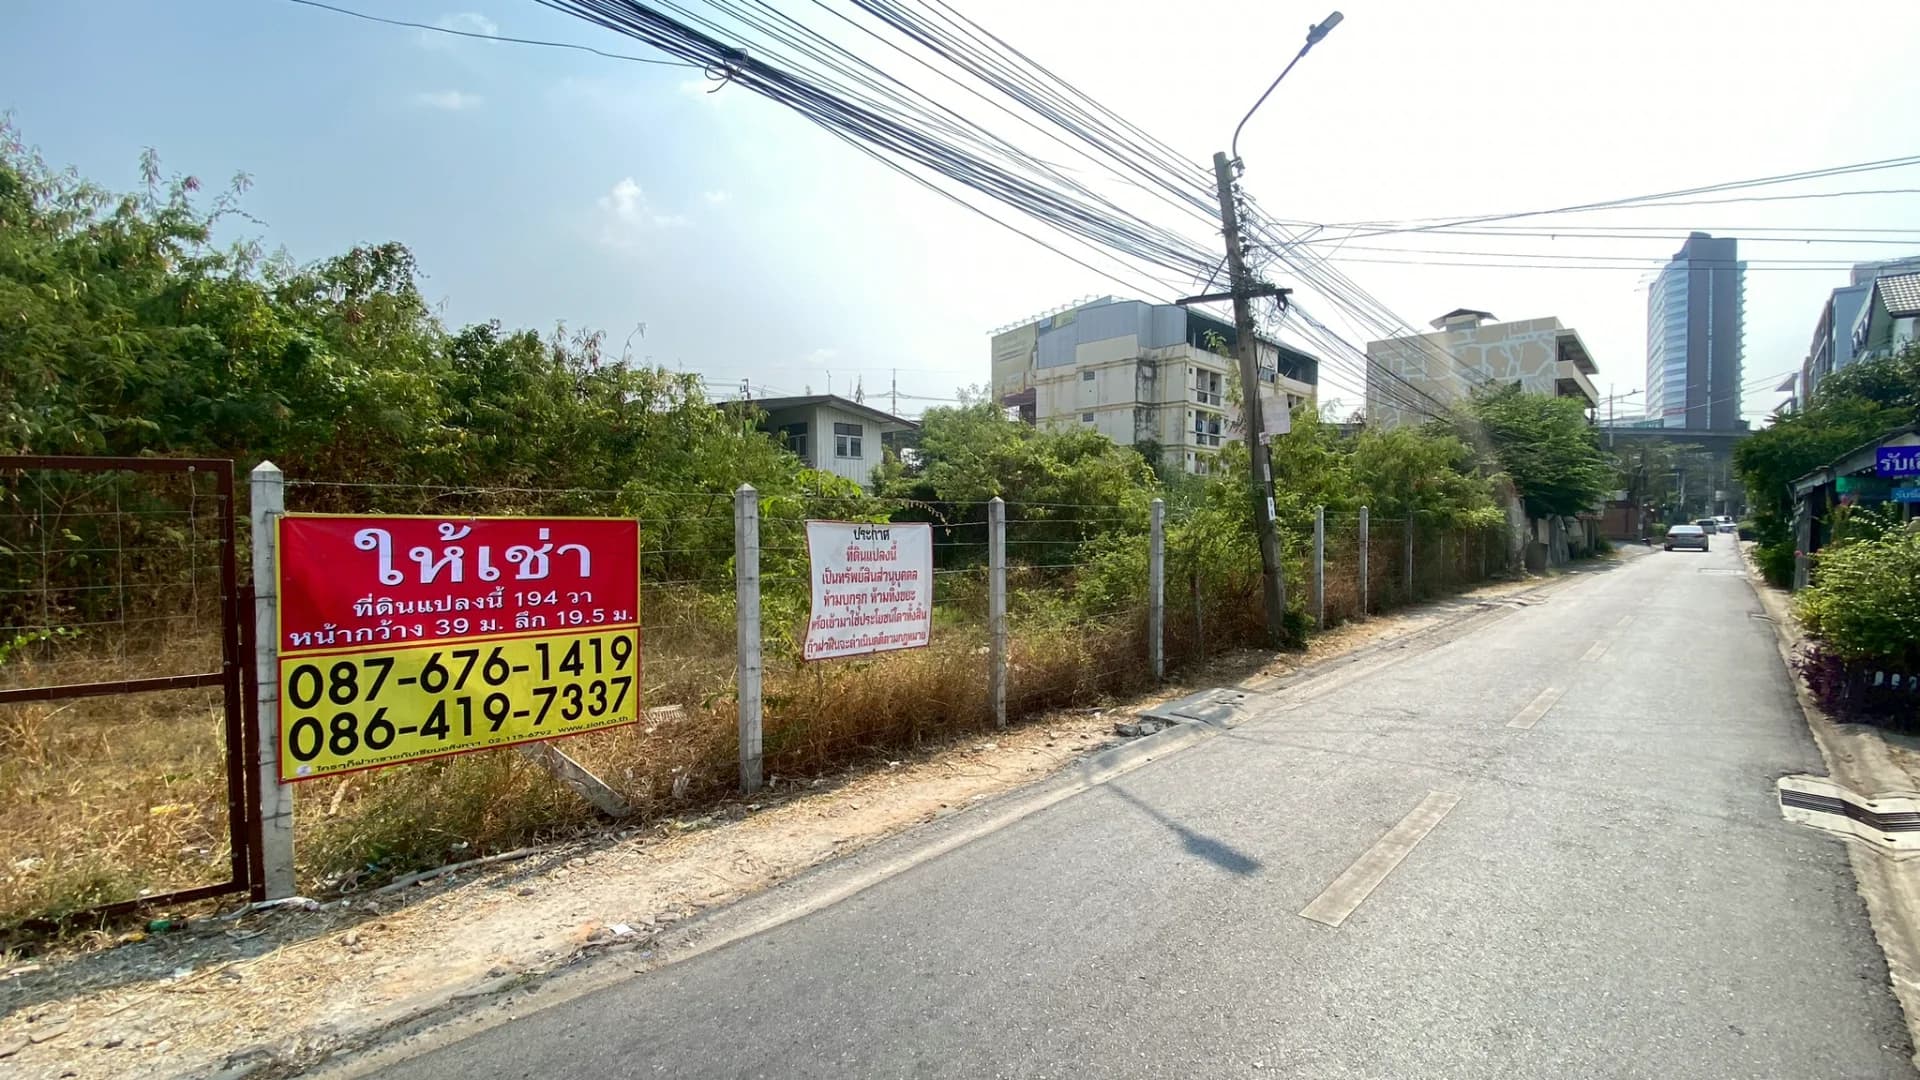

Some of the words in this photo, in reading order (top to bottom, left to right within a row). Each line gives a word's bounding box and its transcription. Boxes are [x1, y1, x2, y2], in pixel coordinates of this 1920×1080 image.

[853, 526, 890, 541] ประกาศ
[353, 522, 591, 586] ให้เช่า
[846, 540, 897, 562] ที่ดินแปลงนี้
[822, 566, 918, 588] เป็นทรัพย์สินส่วนบุคคล
[353, 586, 504, 618] ที่ดินแปลงนี้
[513, 590, 558, 607] 194
[567, 590, 593, 605] วา
[824, 590, 867, 612] ห้ามบุกรุก
[871, 587, 916, 604] ห้ามทิ้งขยะ
[289, 617, 424, 647] หน้ากว้าง
[435, 618, 469, 636] 39
[480, 616, 504, 632] ม.
[514, 611, 545, 629] ลึก
[556, 609, 604, 625] 19.5
[612, 607, 633, 622] ม.
[288, 635, 632, 709] 087-676-1419
[288, 676, 632, 761] 086-419-7337
[557, 715, 629, 733] www.zion.co.th
